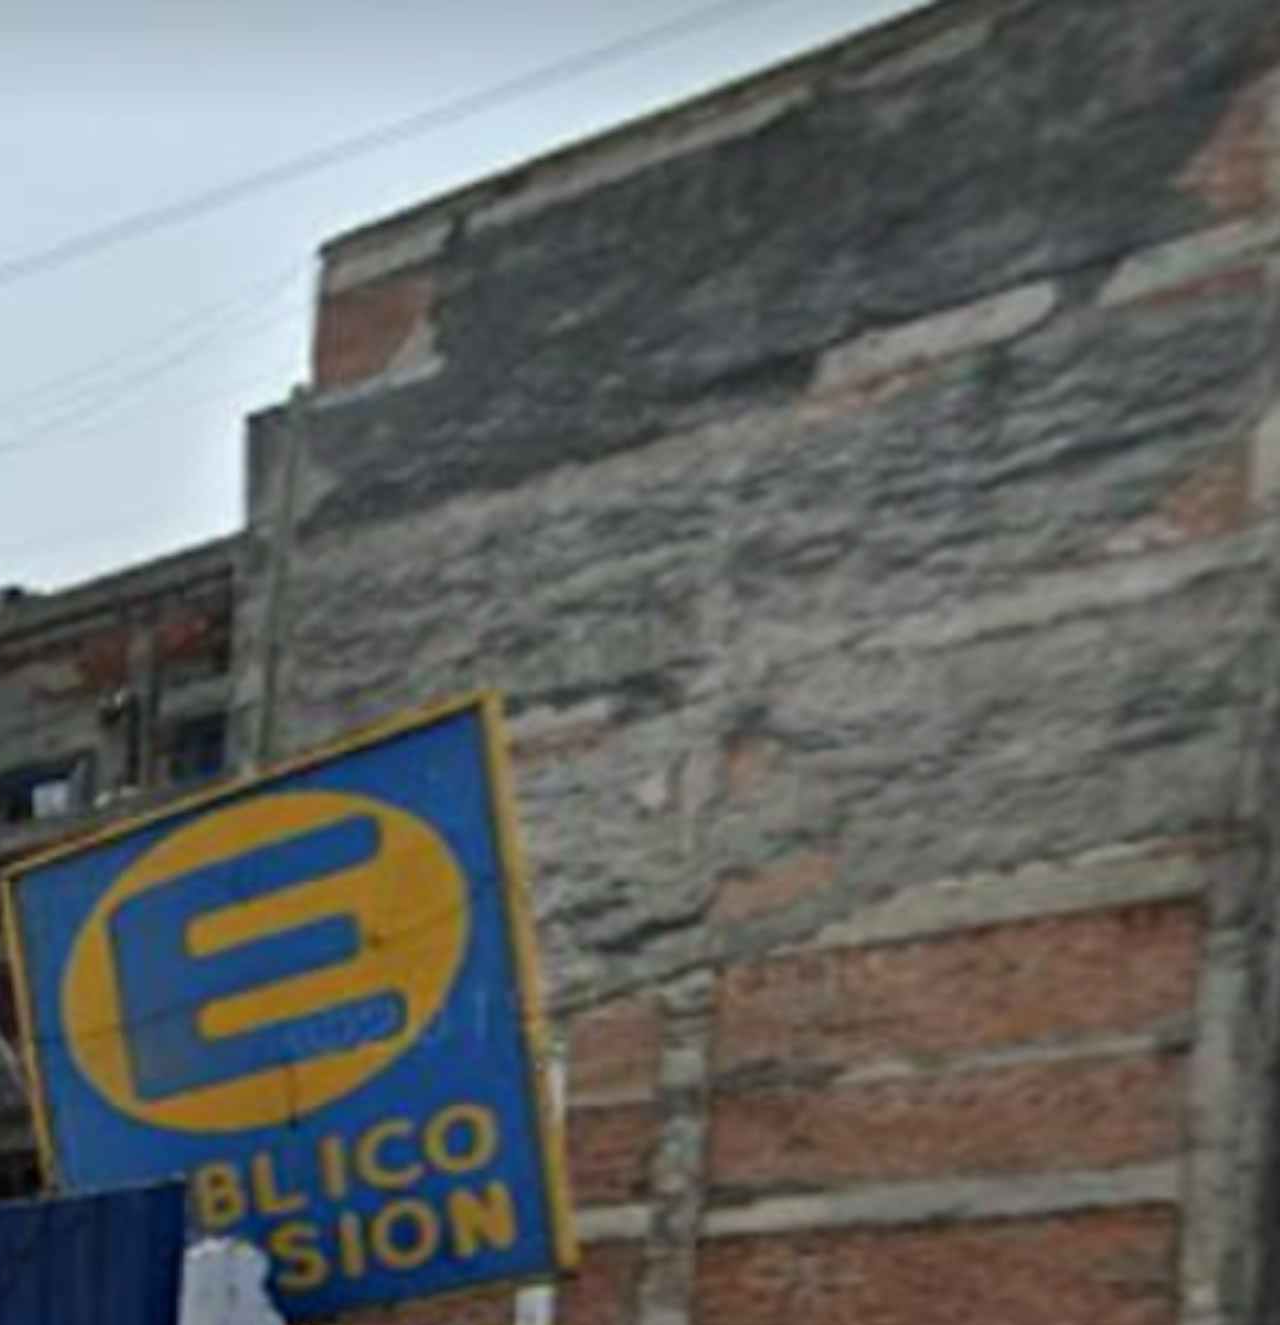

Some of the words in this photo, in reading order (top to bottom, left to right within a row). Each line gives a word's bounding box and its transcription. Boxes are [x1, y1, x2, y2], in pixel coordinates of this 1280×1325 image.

[108, 811, 408, 1102] E
[193, 1103, 497, 1229] BLICO
[269, 1181, 517, 1289] SION
